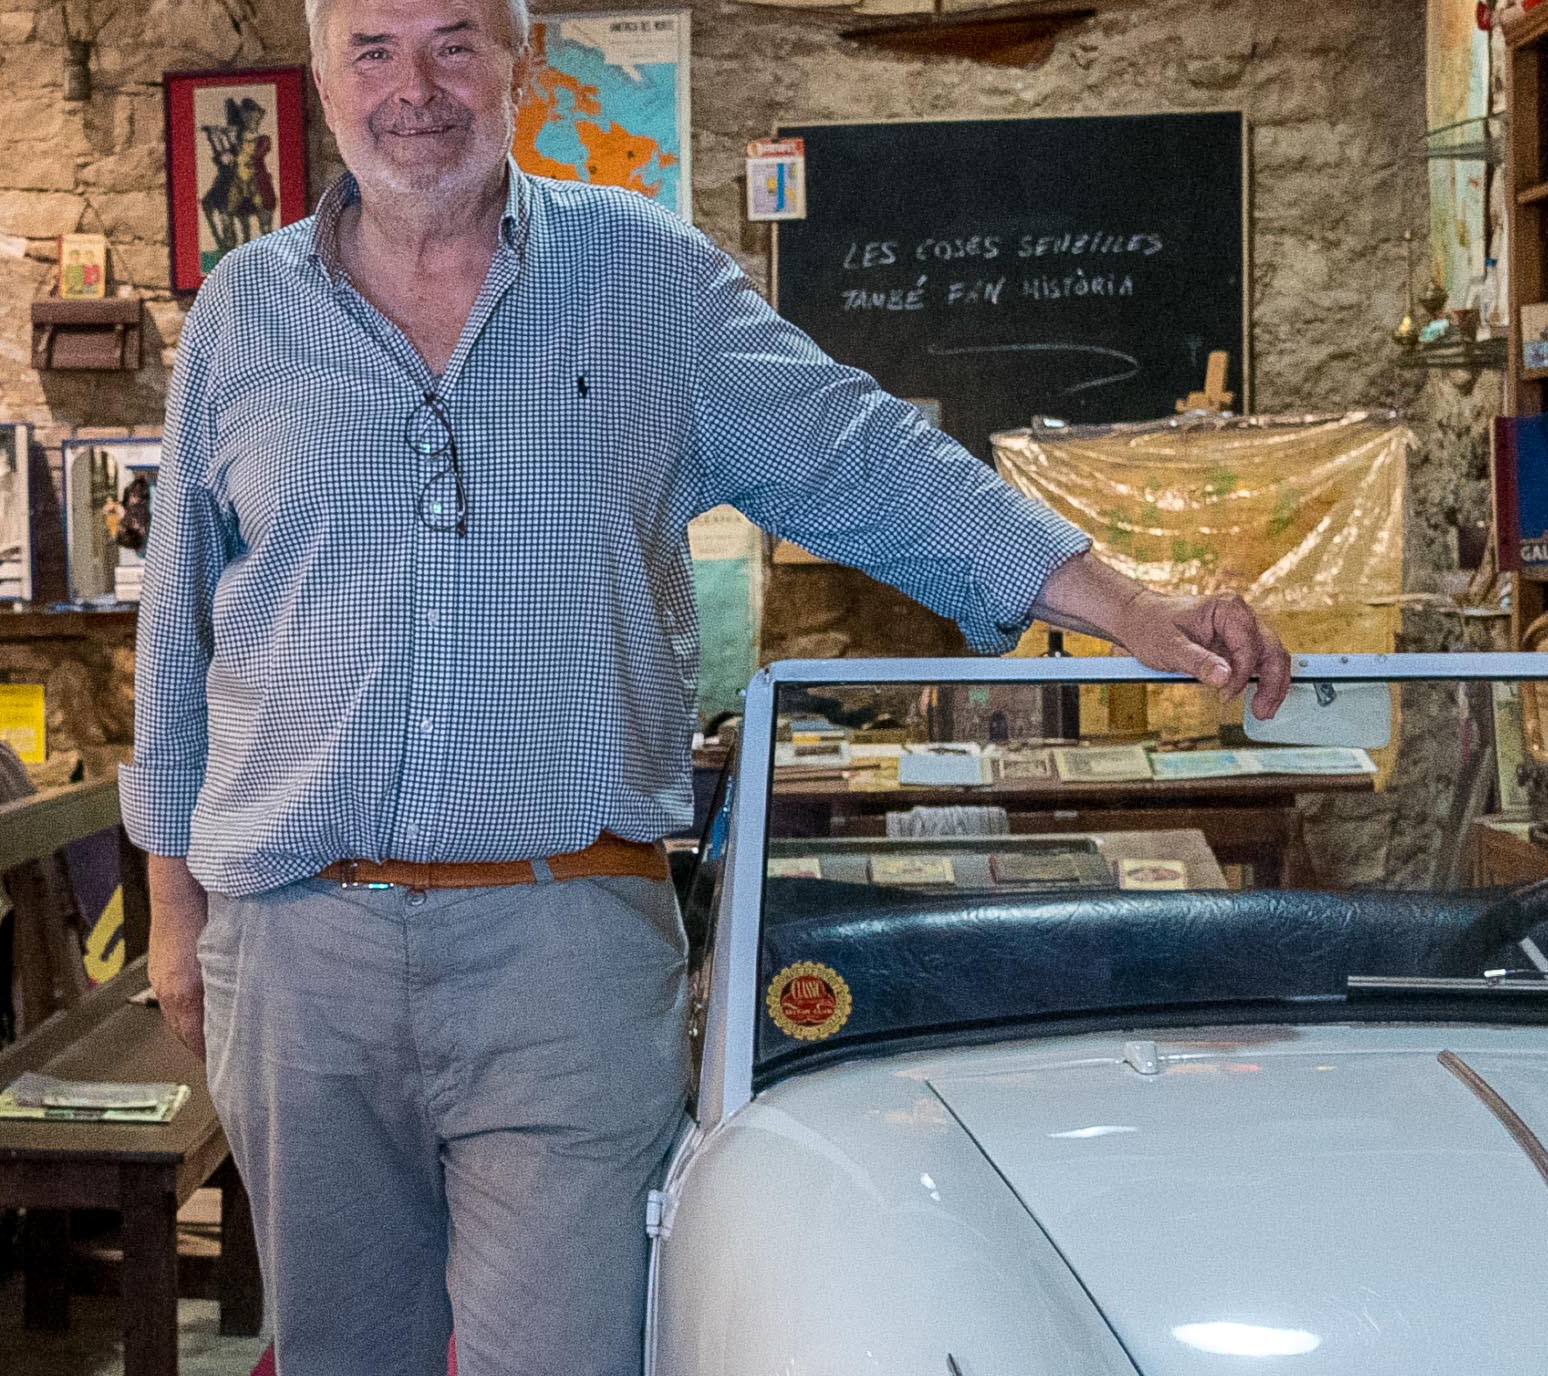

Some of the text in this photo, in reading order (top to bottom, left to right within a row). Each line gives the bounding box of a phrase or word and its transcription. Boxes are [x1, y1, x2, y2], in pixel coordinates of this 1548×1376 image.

[843, 241, 898, 269] LES
[915, 235, 1000, 261] COSES
[841, 274, 928, 311] TAMBÉ
[947, 276, 1005, 304] FAN
